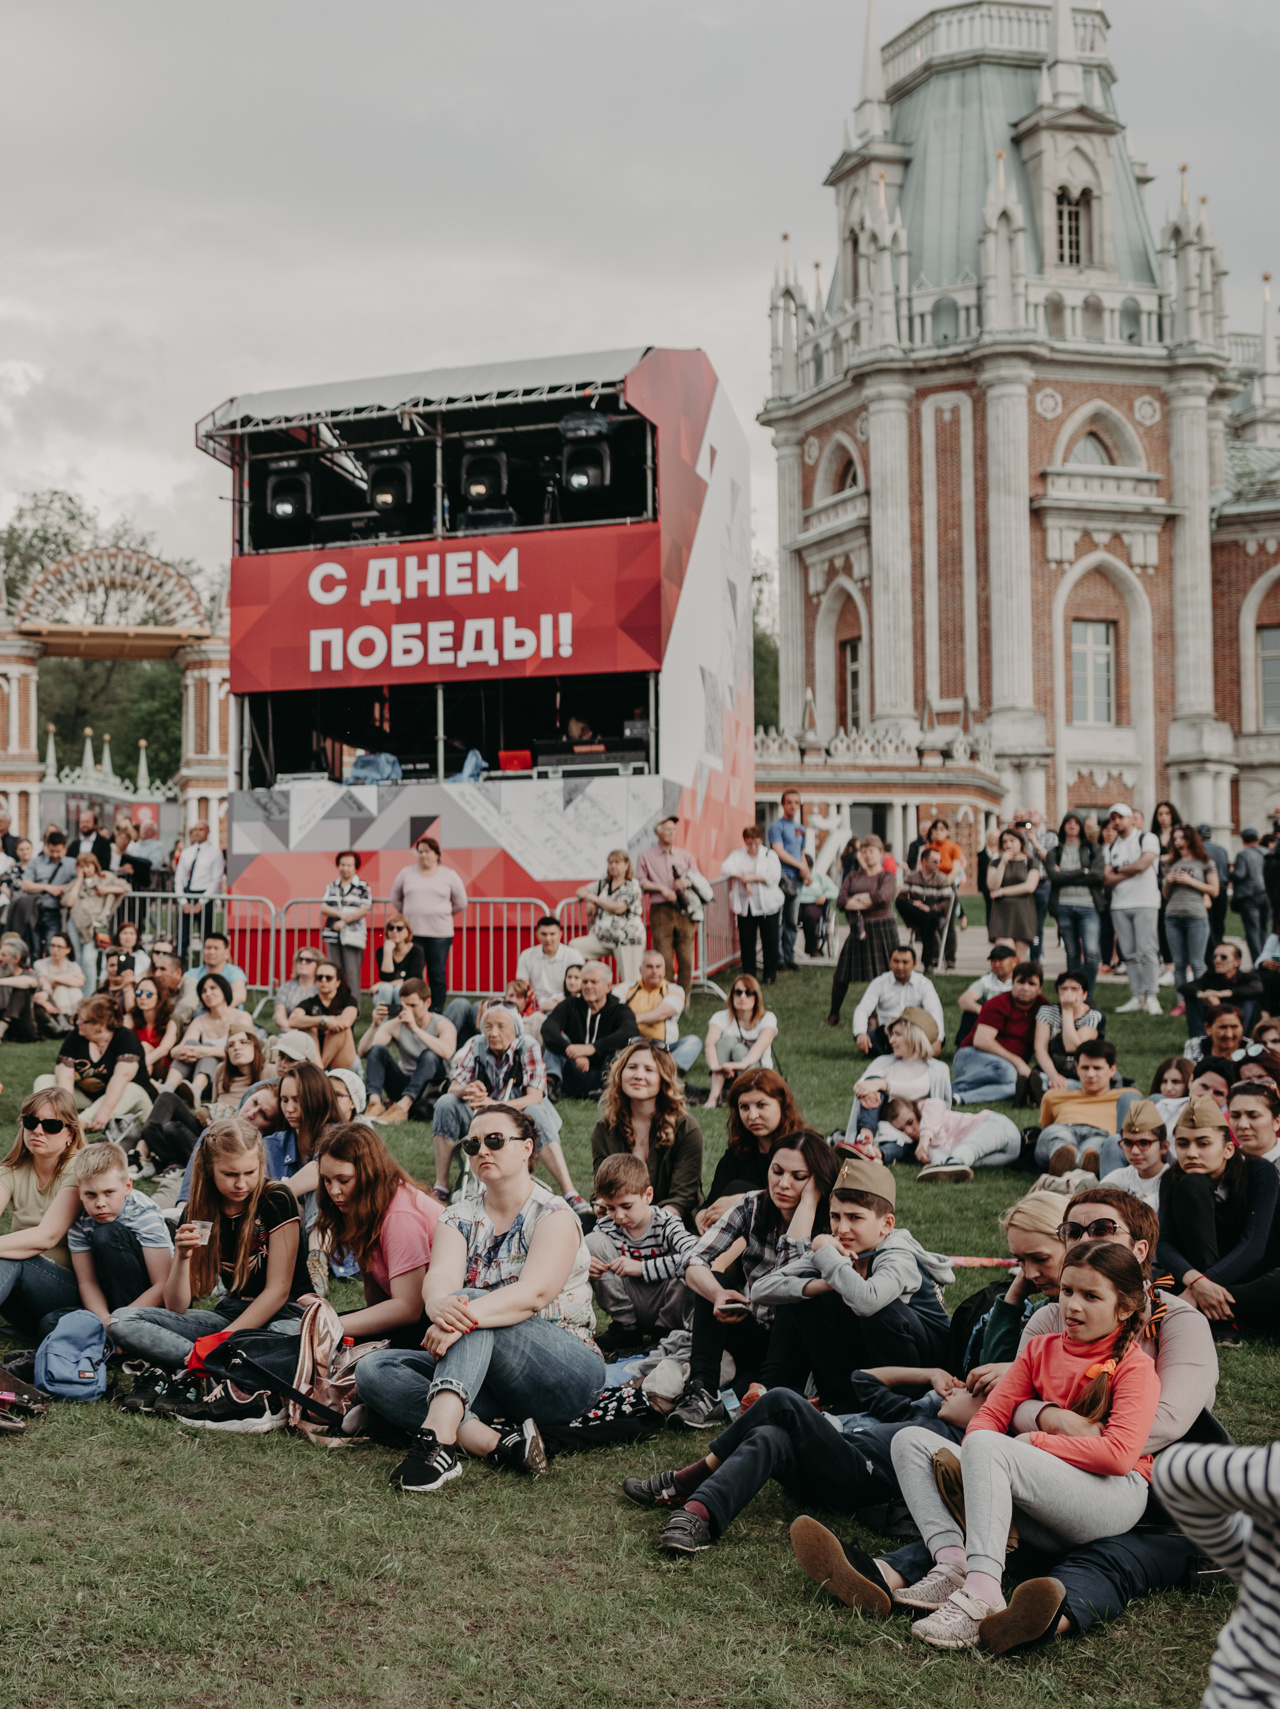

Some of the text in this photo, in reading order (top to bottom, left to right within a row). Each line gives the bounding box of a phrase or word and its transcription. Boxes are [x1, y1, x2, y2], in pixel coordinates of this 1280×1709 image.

[307, 547, 519, 607] С ДНЕМ
[309, 612, 573, 672] ПОБЕДЫ!
